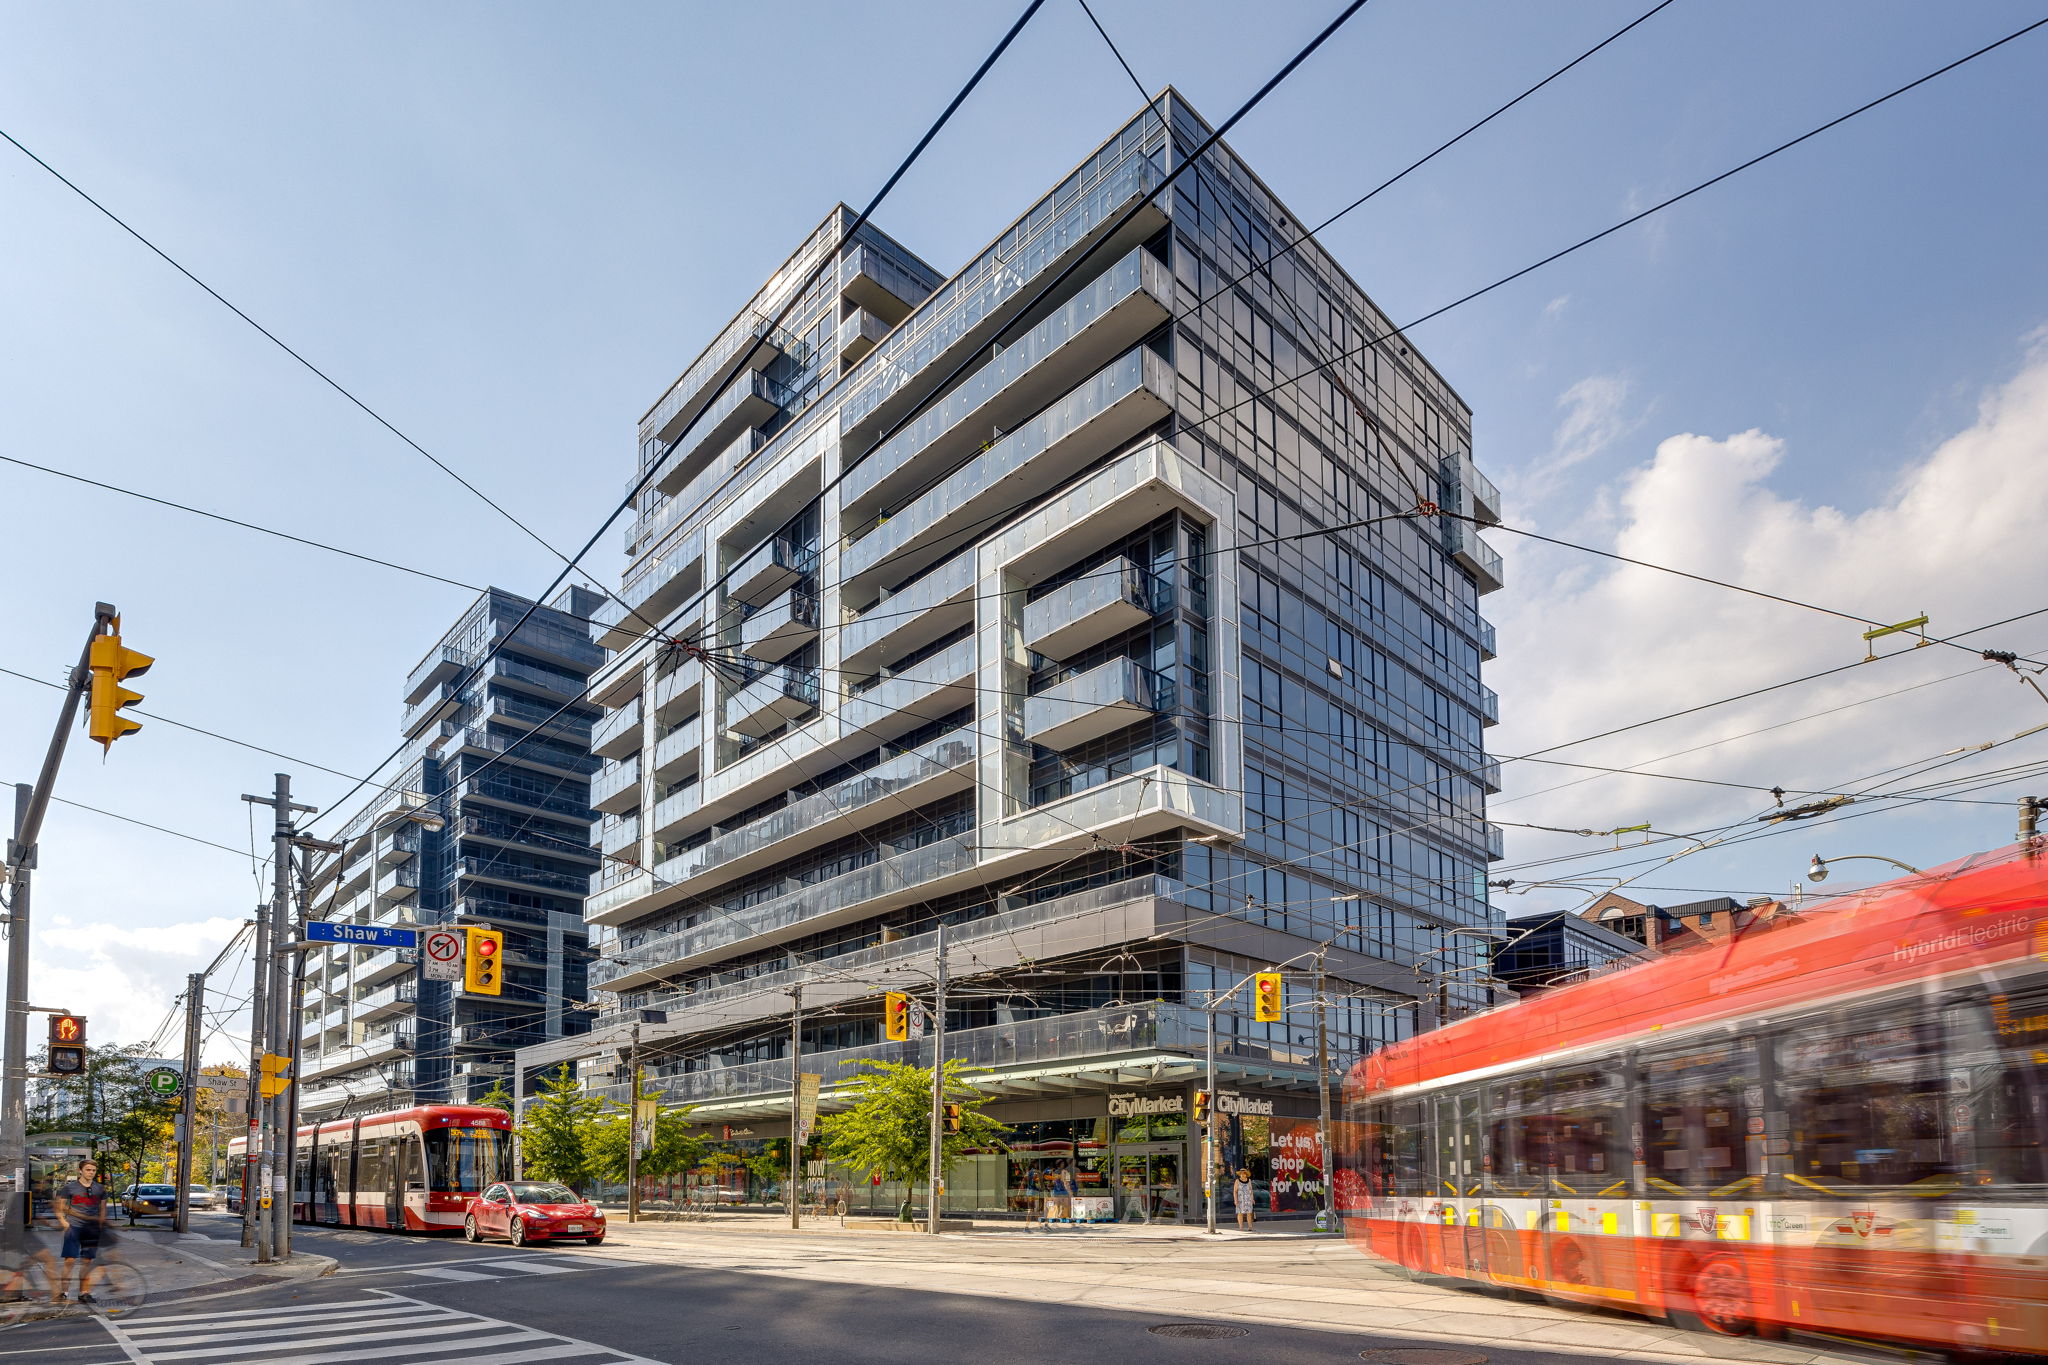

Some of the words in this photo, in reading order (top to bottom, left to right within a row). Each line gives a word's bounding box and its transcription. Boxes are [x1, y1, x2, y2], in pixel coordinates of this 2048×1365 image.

[333, 925, 378, 941] Shaw
[383, 929, 392, 937] St
[1893, 913, 2030, 963] HybridElectric
[157, 1075, 173, 1088] P
[208, 1078, 227, 1087] Shaw
[1108, 1095, 1184, 1118] CityMarket
[1217, 1095, 1273, 1116] CityMarket
[1270, 1132, 1293, 1147] Let
[1295, 1136, 1312, 1148] us
[807, 1160, 826, 1177] NOW
[1271, 1154, 1305, 1174] shop
[807, 1177, 826, 1194] OPEN
[1271, 1176, 1292, 1193] for
[1297, 1180, 1320, 1197] you
